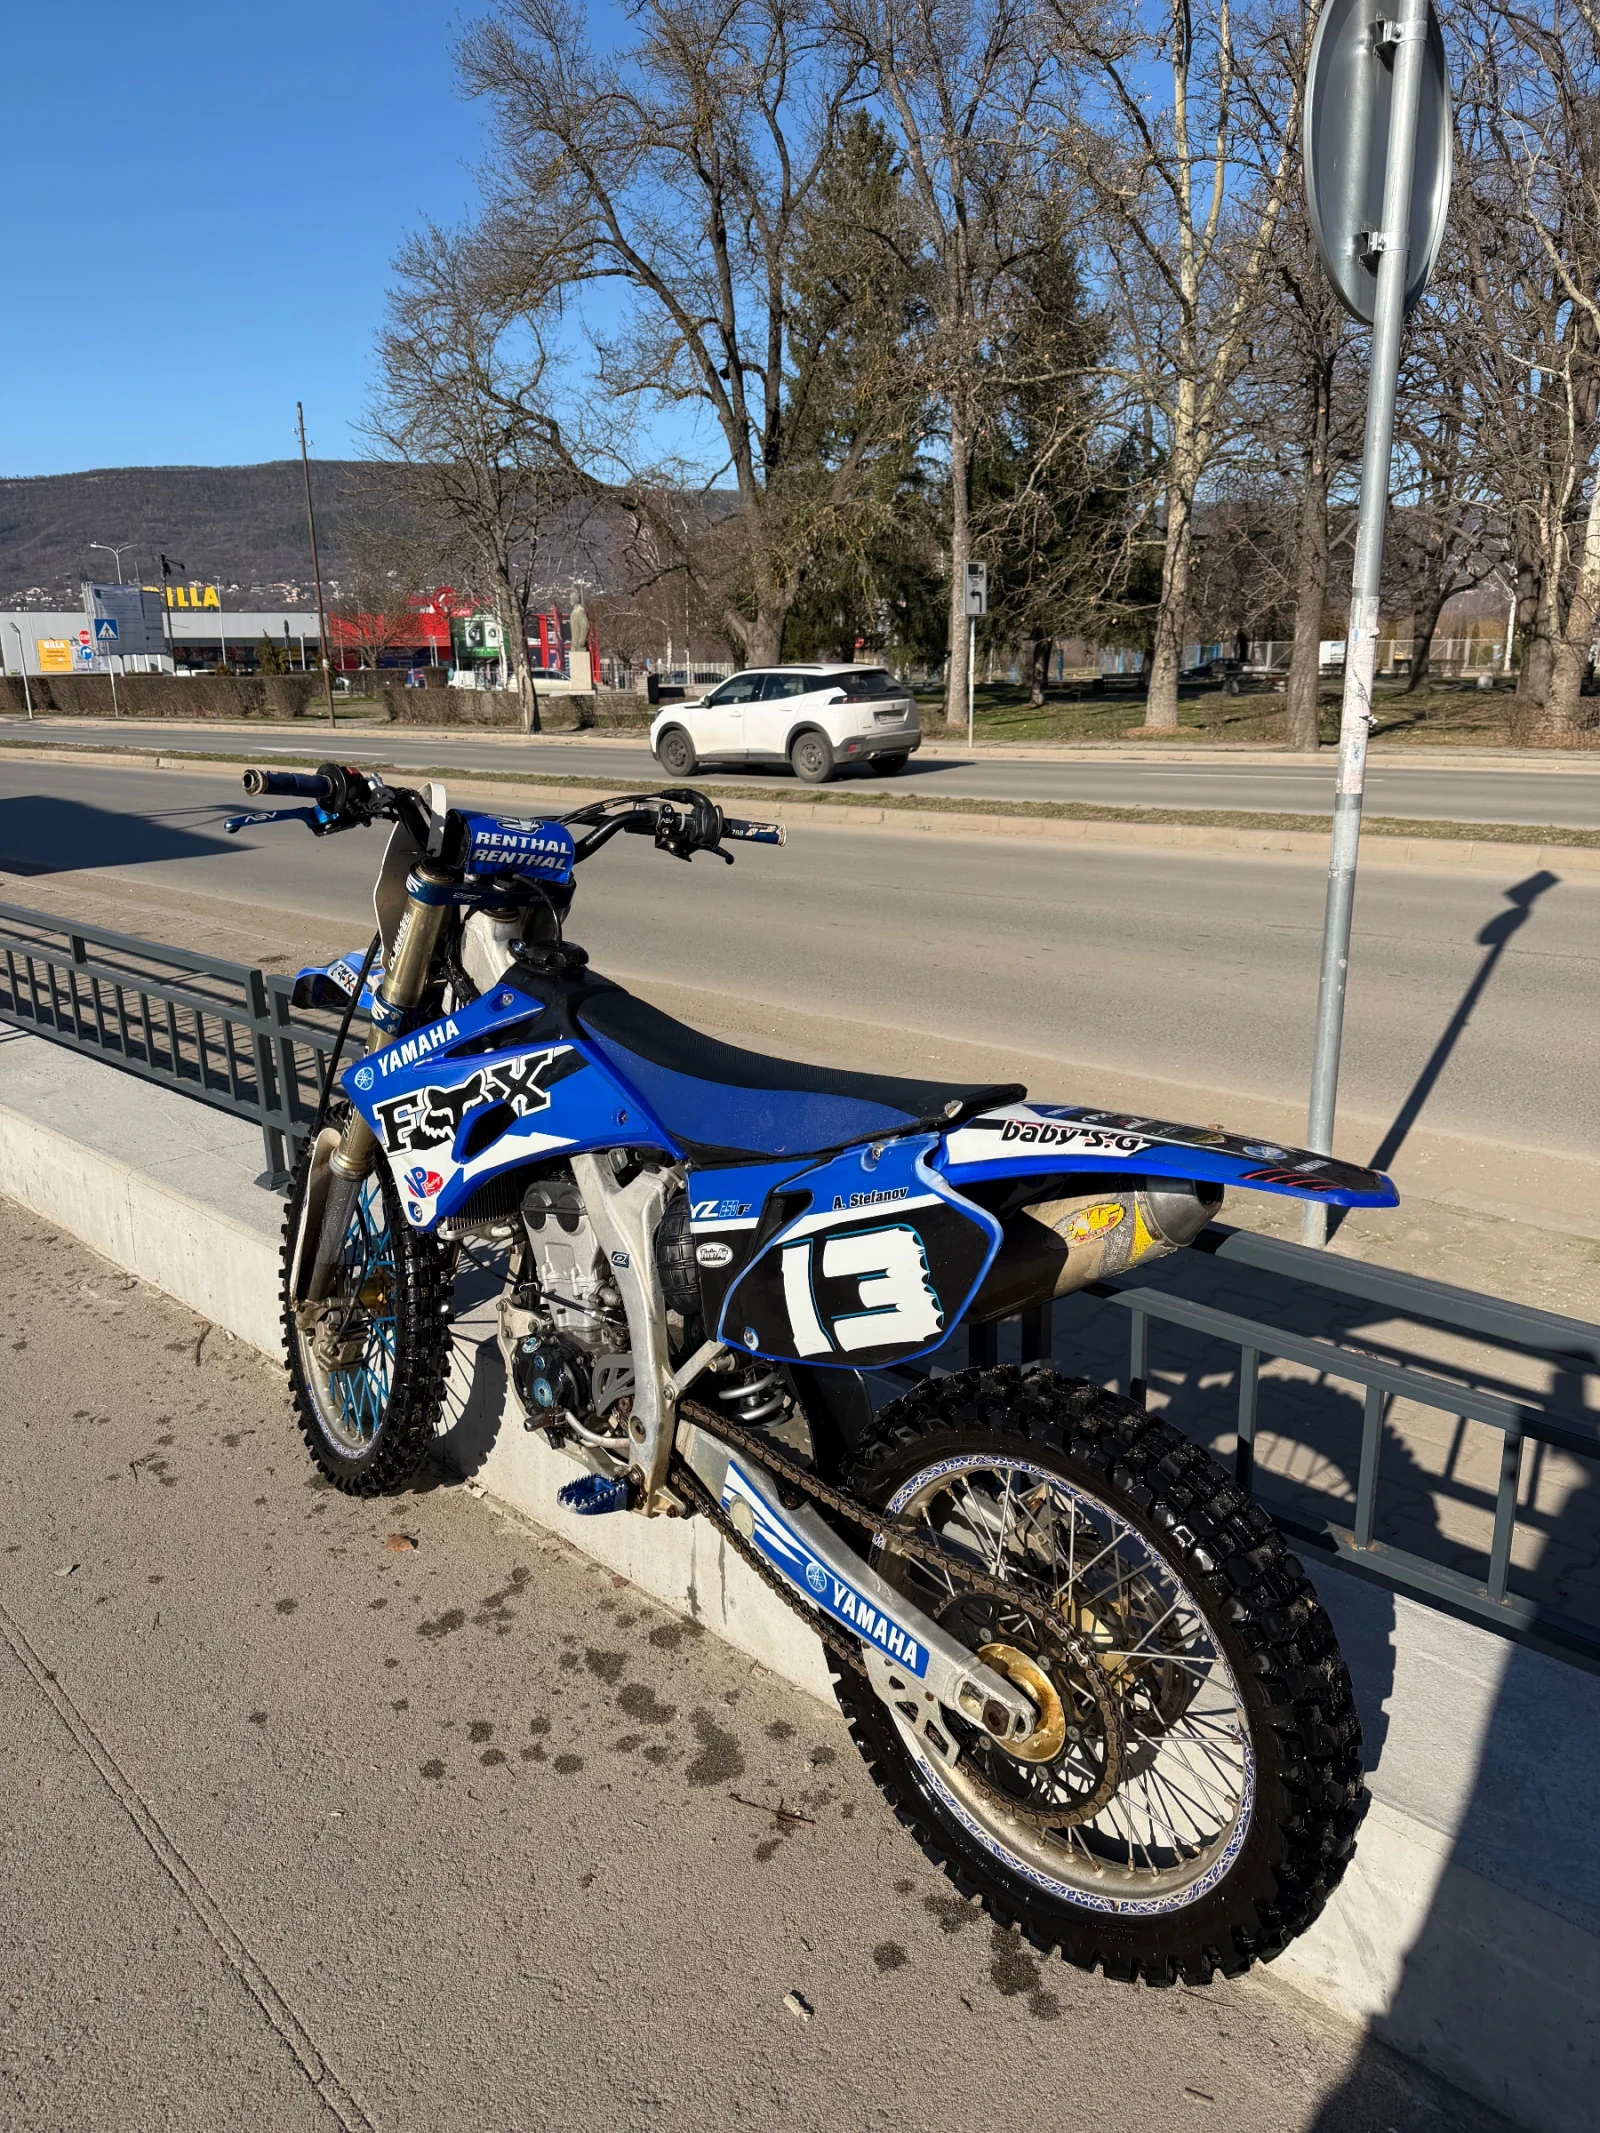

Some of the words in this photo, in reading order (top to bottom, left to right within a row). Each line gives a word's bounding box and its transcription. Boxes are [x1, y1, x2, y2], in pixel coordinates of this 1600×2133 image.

[142, 586, 220, 607] ILLA
[244, 811, 277, 823] ASV
[475, 831, 571, 855] RENTHAL
[471, 848, 567, 870] RENTHAL
[377, 1019, 460, 1077] YAMAHA
[1001, 1118, 1081, 1146] baby
[403, 1166, 427, 1198] VP
[833, 1195, 846, 1211] A.
[850, 1186, 909, 1208] Stefanov
[700, 1247, 717, 1261] Twin
[717, 1247, 729, 1261] Air
[781, 1223, 945, 1358] 13
[832, 1580, 919, 1670] YAMAHA
